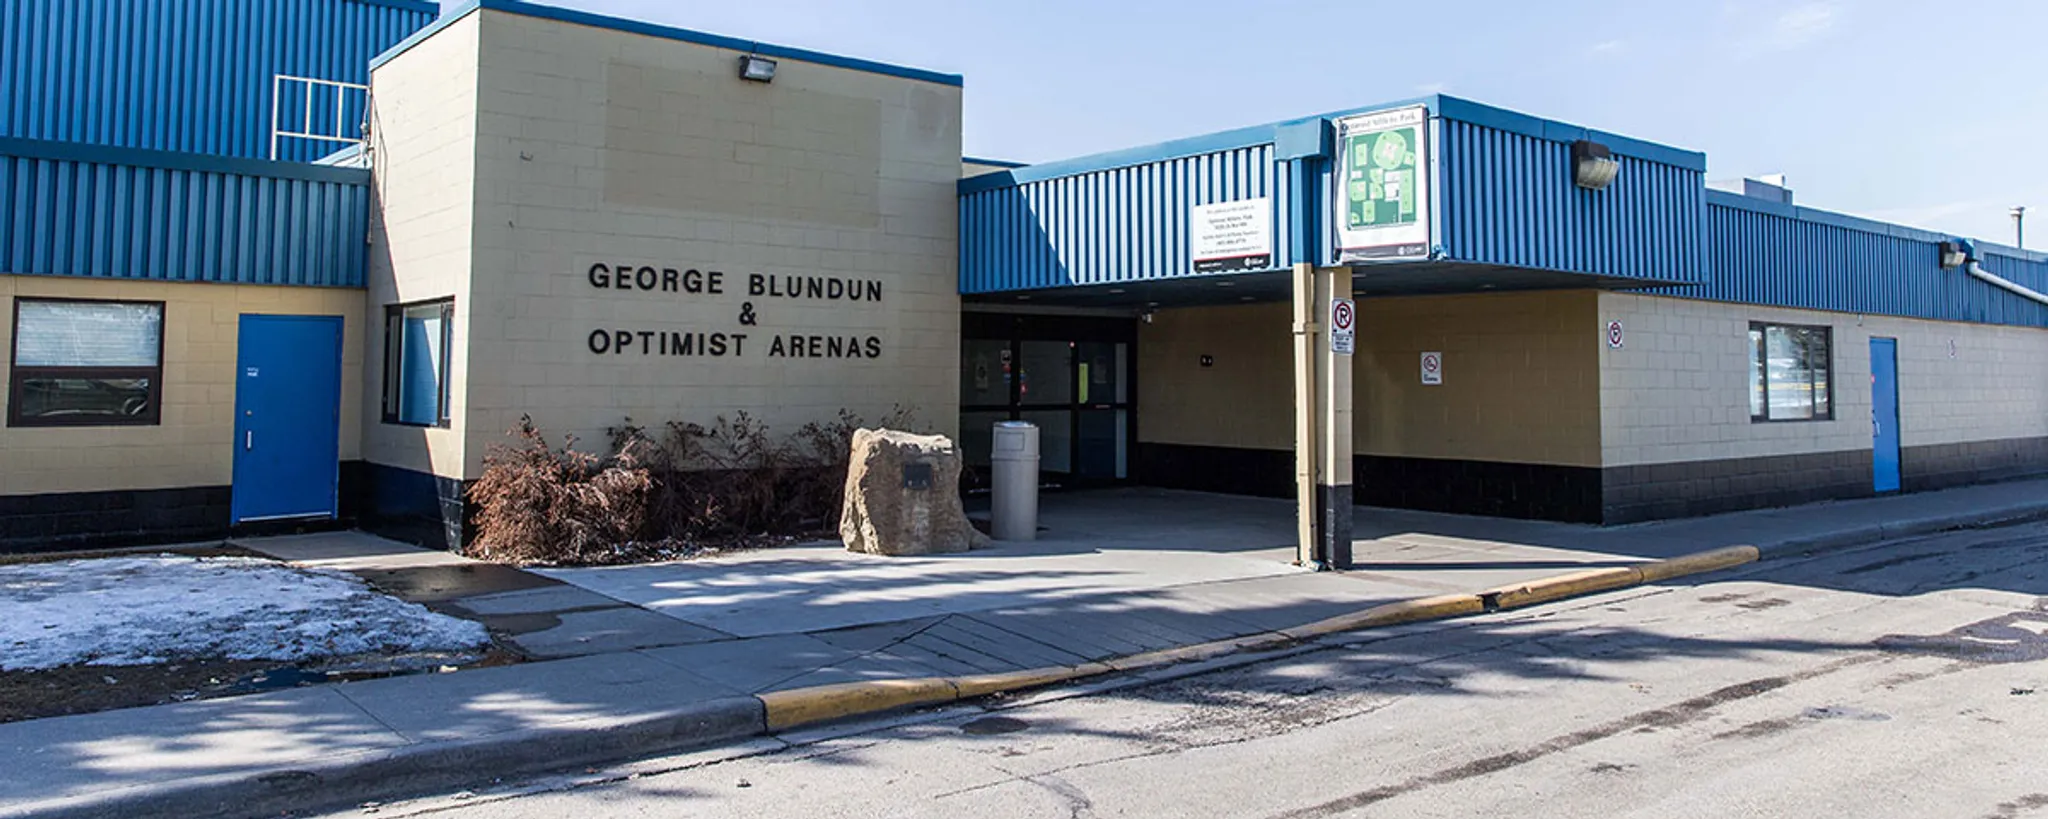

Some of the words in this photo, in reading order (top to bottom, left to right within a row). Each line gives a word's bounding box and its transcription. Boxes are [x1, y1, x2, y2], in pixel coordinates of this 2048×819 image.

[588, 263, 723, 294] GEORGE
[749, 274, 881, 301] BLUNDUN
[739, 302, 757, 326] &
[588, 329, 747, 356] OPTIMIST
[769, 335, 881, 359] ARENAS
